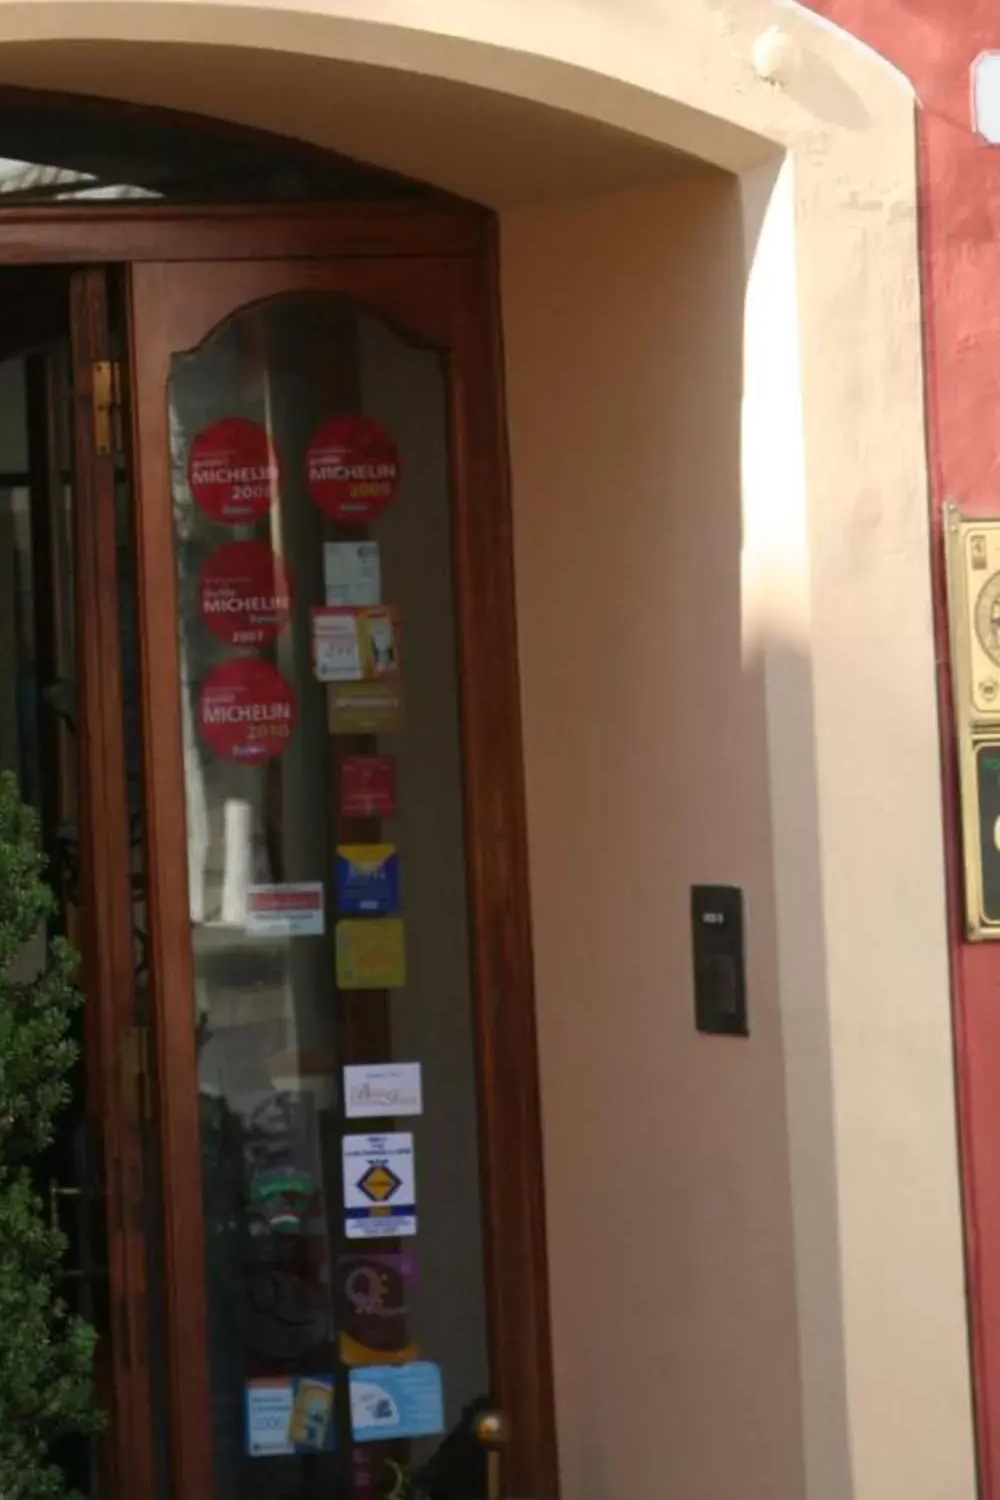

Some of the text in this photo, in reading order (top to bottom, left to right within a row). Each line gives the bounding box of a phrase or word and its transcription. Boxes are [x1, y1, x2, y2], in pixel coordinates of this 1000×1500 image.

[308, 462, 397, 482] MICHELIN
[203, 595, 289, 614] MICHELIN
[203, 702, 290, 725] MICHELIN
